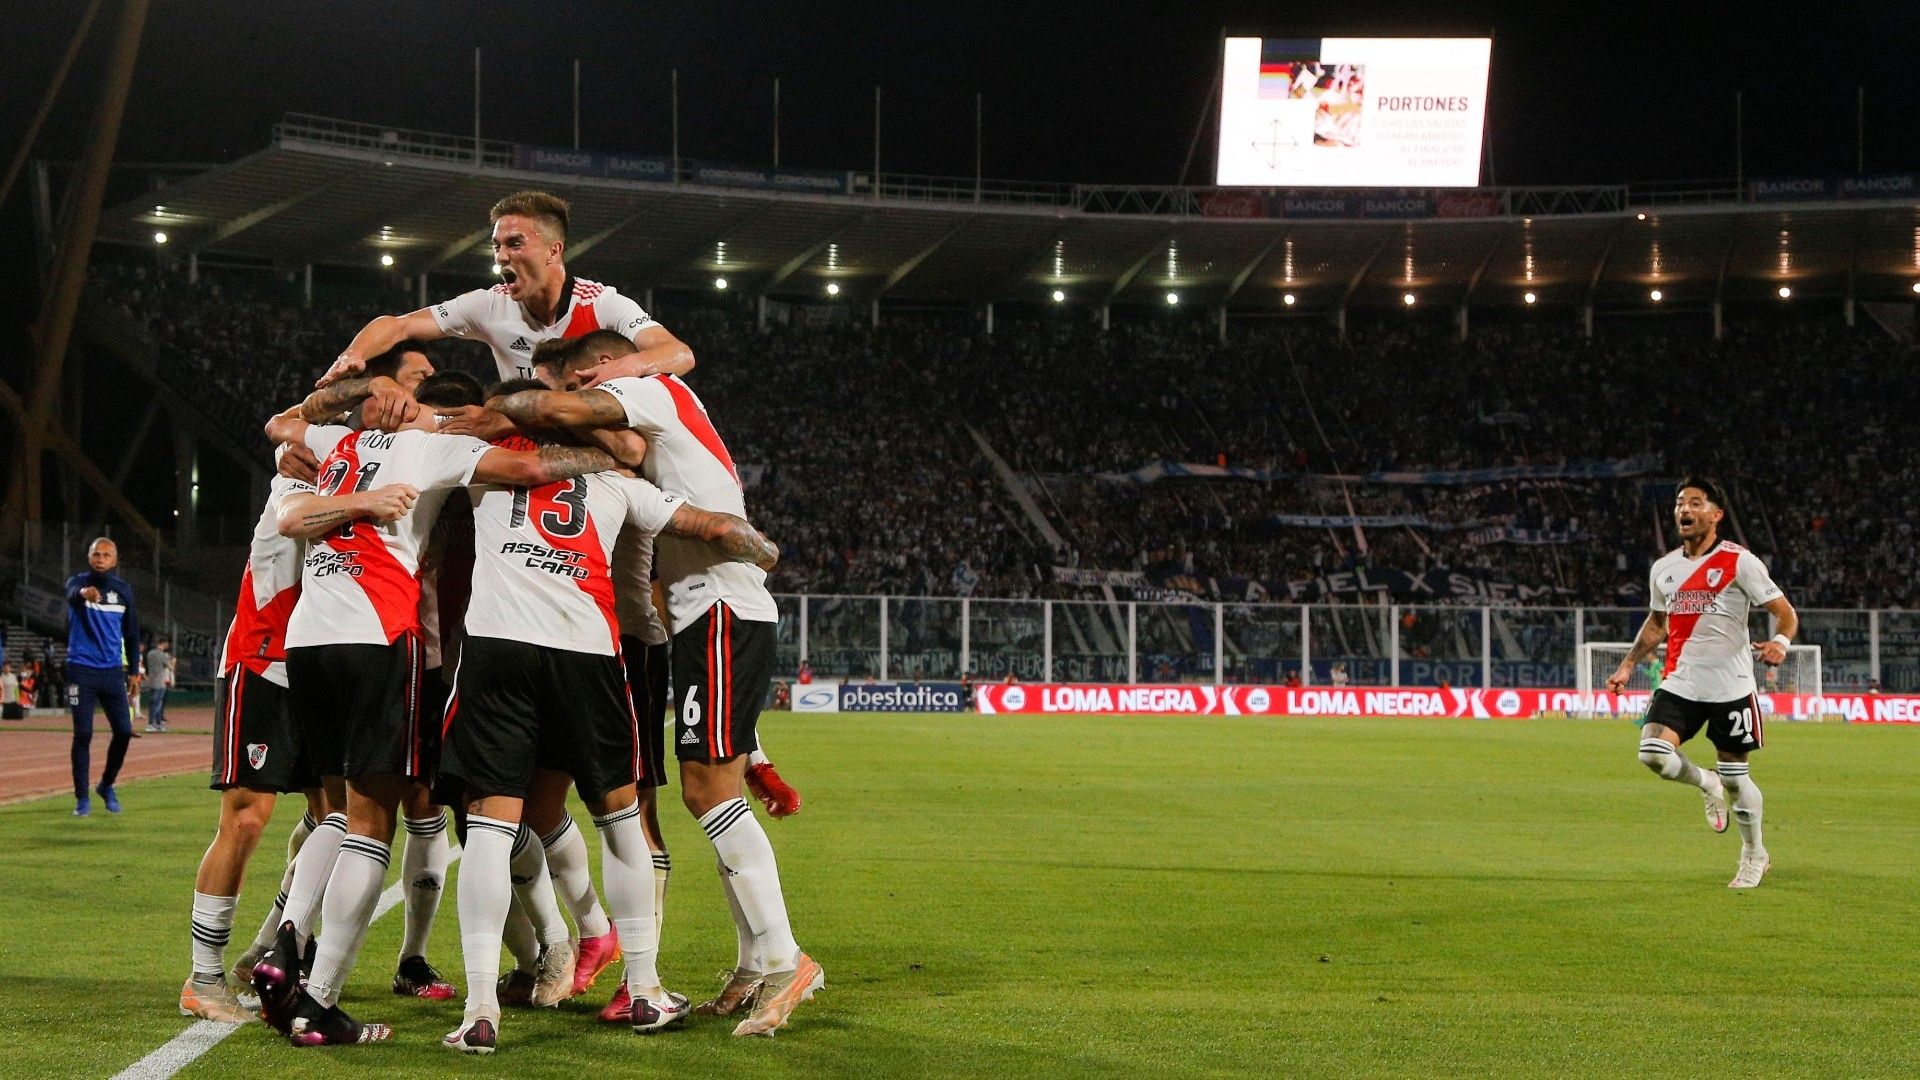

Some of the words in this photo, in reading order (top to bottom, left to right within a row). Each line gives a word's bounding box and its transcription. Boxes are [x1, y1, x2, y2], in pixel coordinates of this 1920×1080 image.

[1378, 96, 1469, 111] PORTONES
[609, 157, 665, 174] BANCOR
[1757, 179, 1825, 193] BANCOR
[1844, 176, 1912, 190] BANCOR
[1285, 199, 1344, 211] BANCOR
[1365, 199, 1426, 211] BANCOR
[509, 474, 588, 538] 13
[500, 542, 586, 564] ASSIST
[525, 557, 589, 580] CARD
[1287, 569, 1389, 600] FIEL
[1403, 570, 1434, 594] X
[1412, 661, 1475, 687] POR
[683, 685, 701, 726] 6
[843, 686, 959, 709] pbestatica
[1042, 687, 1114, 712] LOMA
[1118, 688, 1197, 712] NEGRA
[1287, 690, 1361, 714] LOMA
[1365, 691, 1446, 715] NEGRA
[1538, 692, 1611, 713] LOMA
[1793, 696, 1869, 721] LOMA
[1728, 707, 1753, 736] 20
